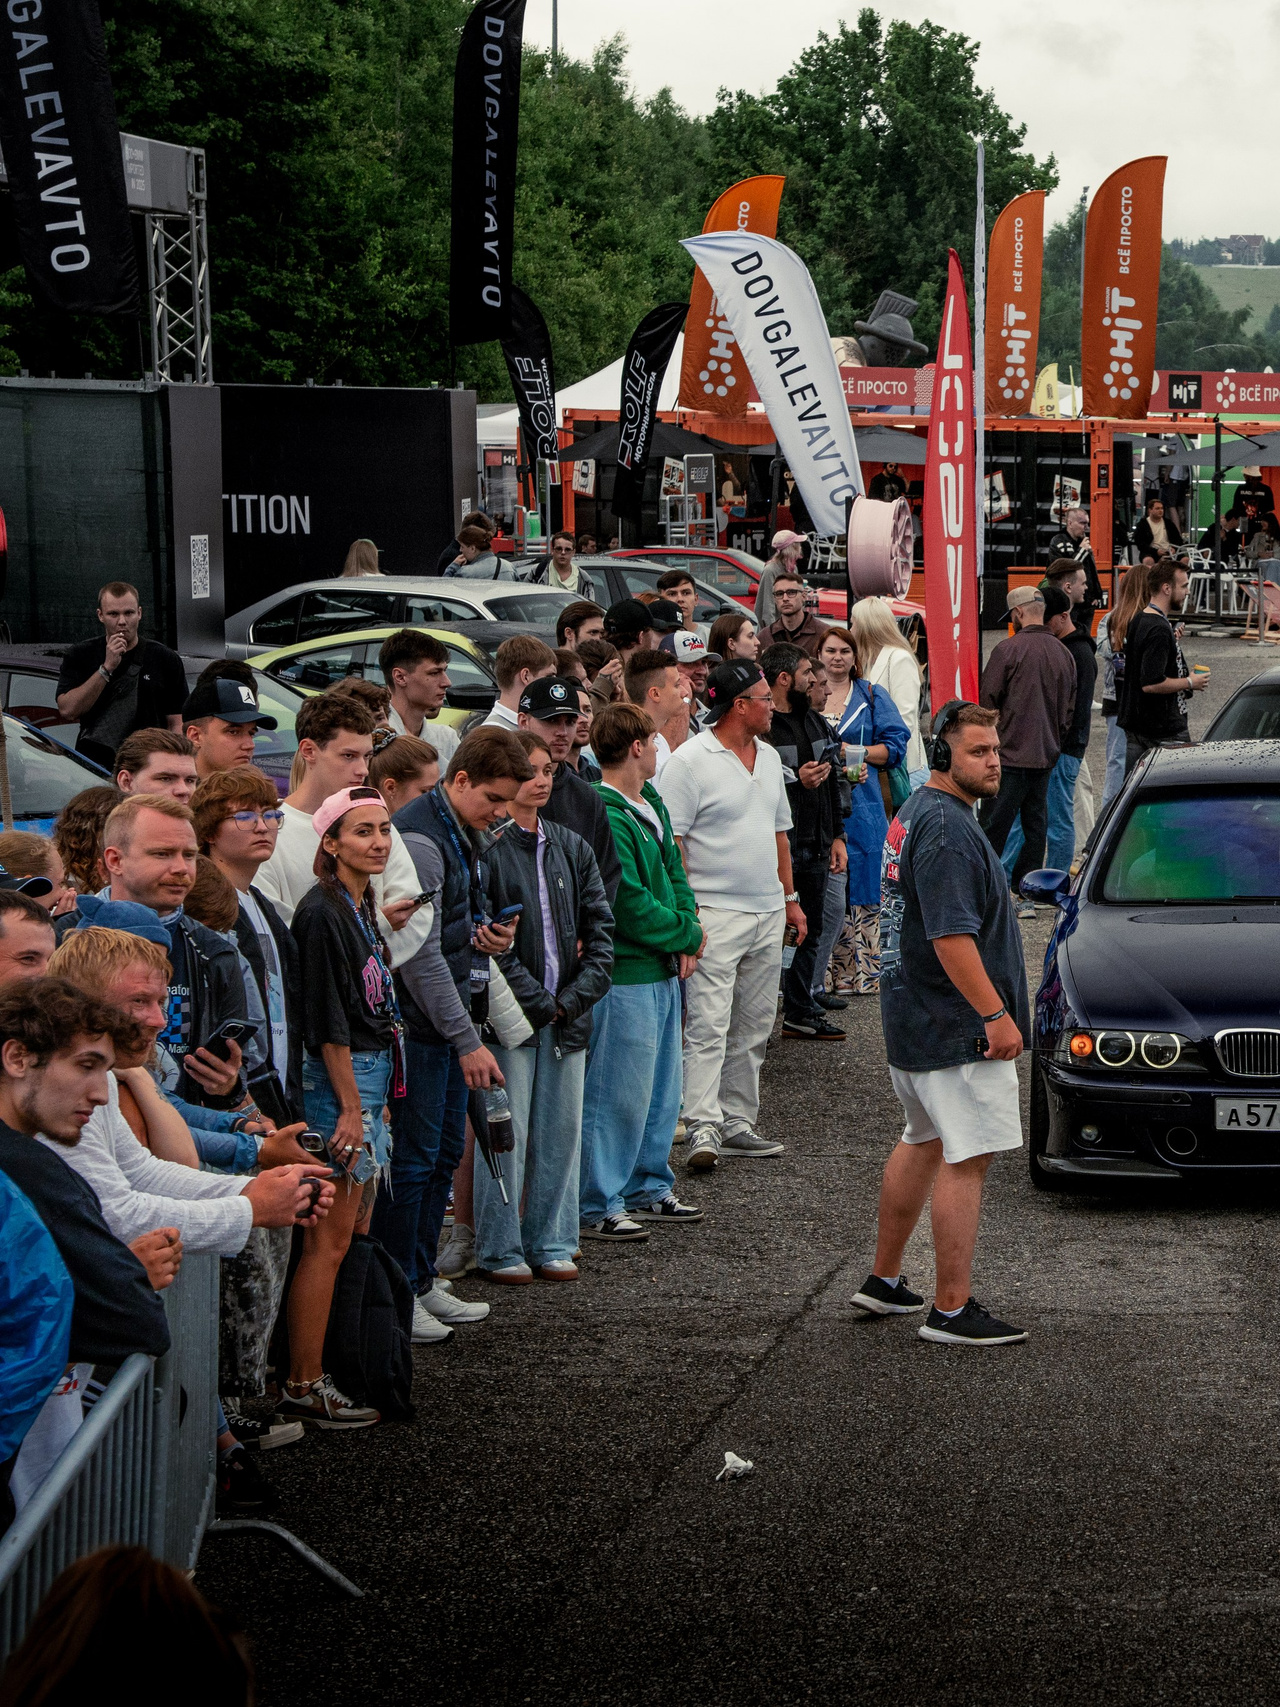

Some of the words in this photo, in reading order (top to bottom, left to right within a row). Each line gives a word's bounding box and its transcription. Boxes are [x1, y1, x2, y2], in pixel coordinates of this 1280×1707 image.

[481, 15, 506, 308] DOVGALEVAVTO
[1120, 186, 1133, 246] ПРОСТО
[1014, 217, 1024, 268] ПРОСТО
[1117, 248, 1131, 274] ВСЁ
[1012, 270, 1023, 292] ВСЁ
[644, 371, 657, 407] МАСЛА
[731, 251, 858, 506] DOVGALEVAVTO
[842, 377, 854, 395] СЁ
[857, 380, 908, 395] ПРОСТО
[1239, 384, 1261, 402] ВСЁ
